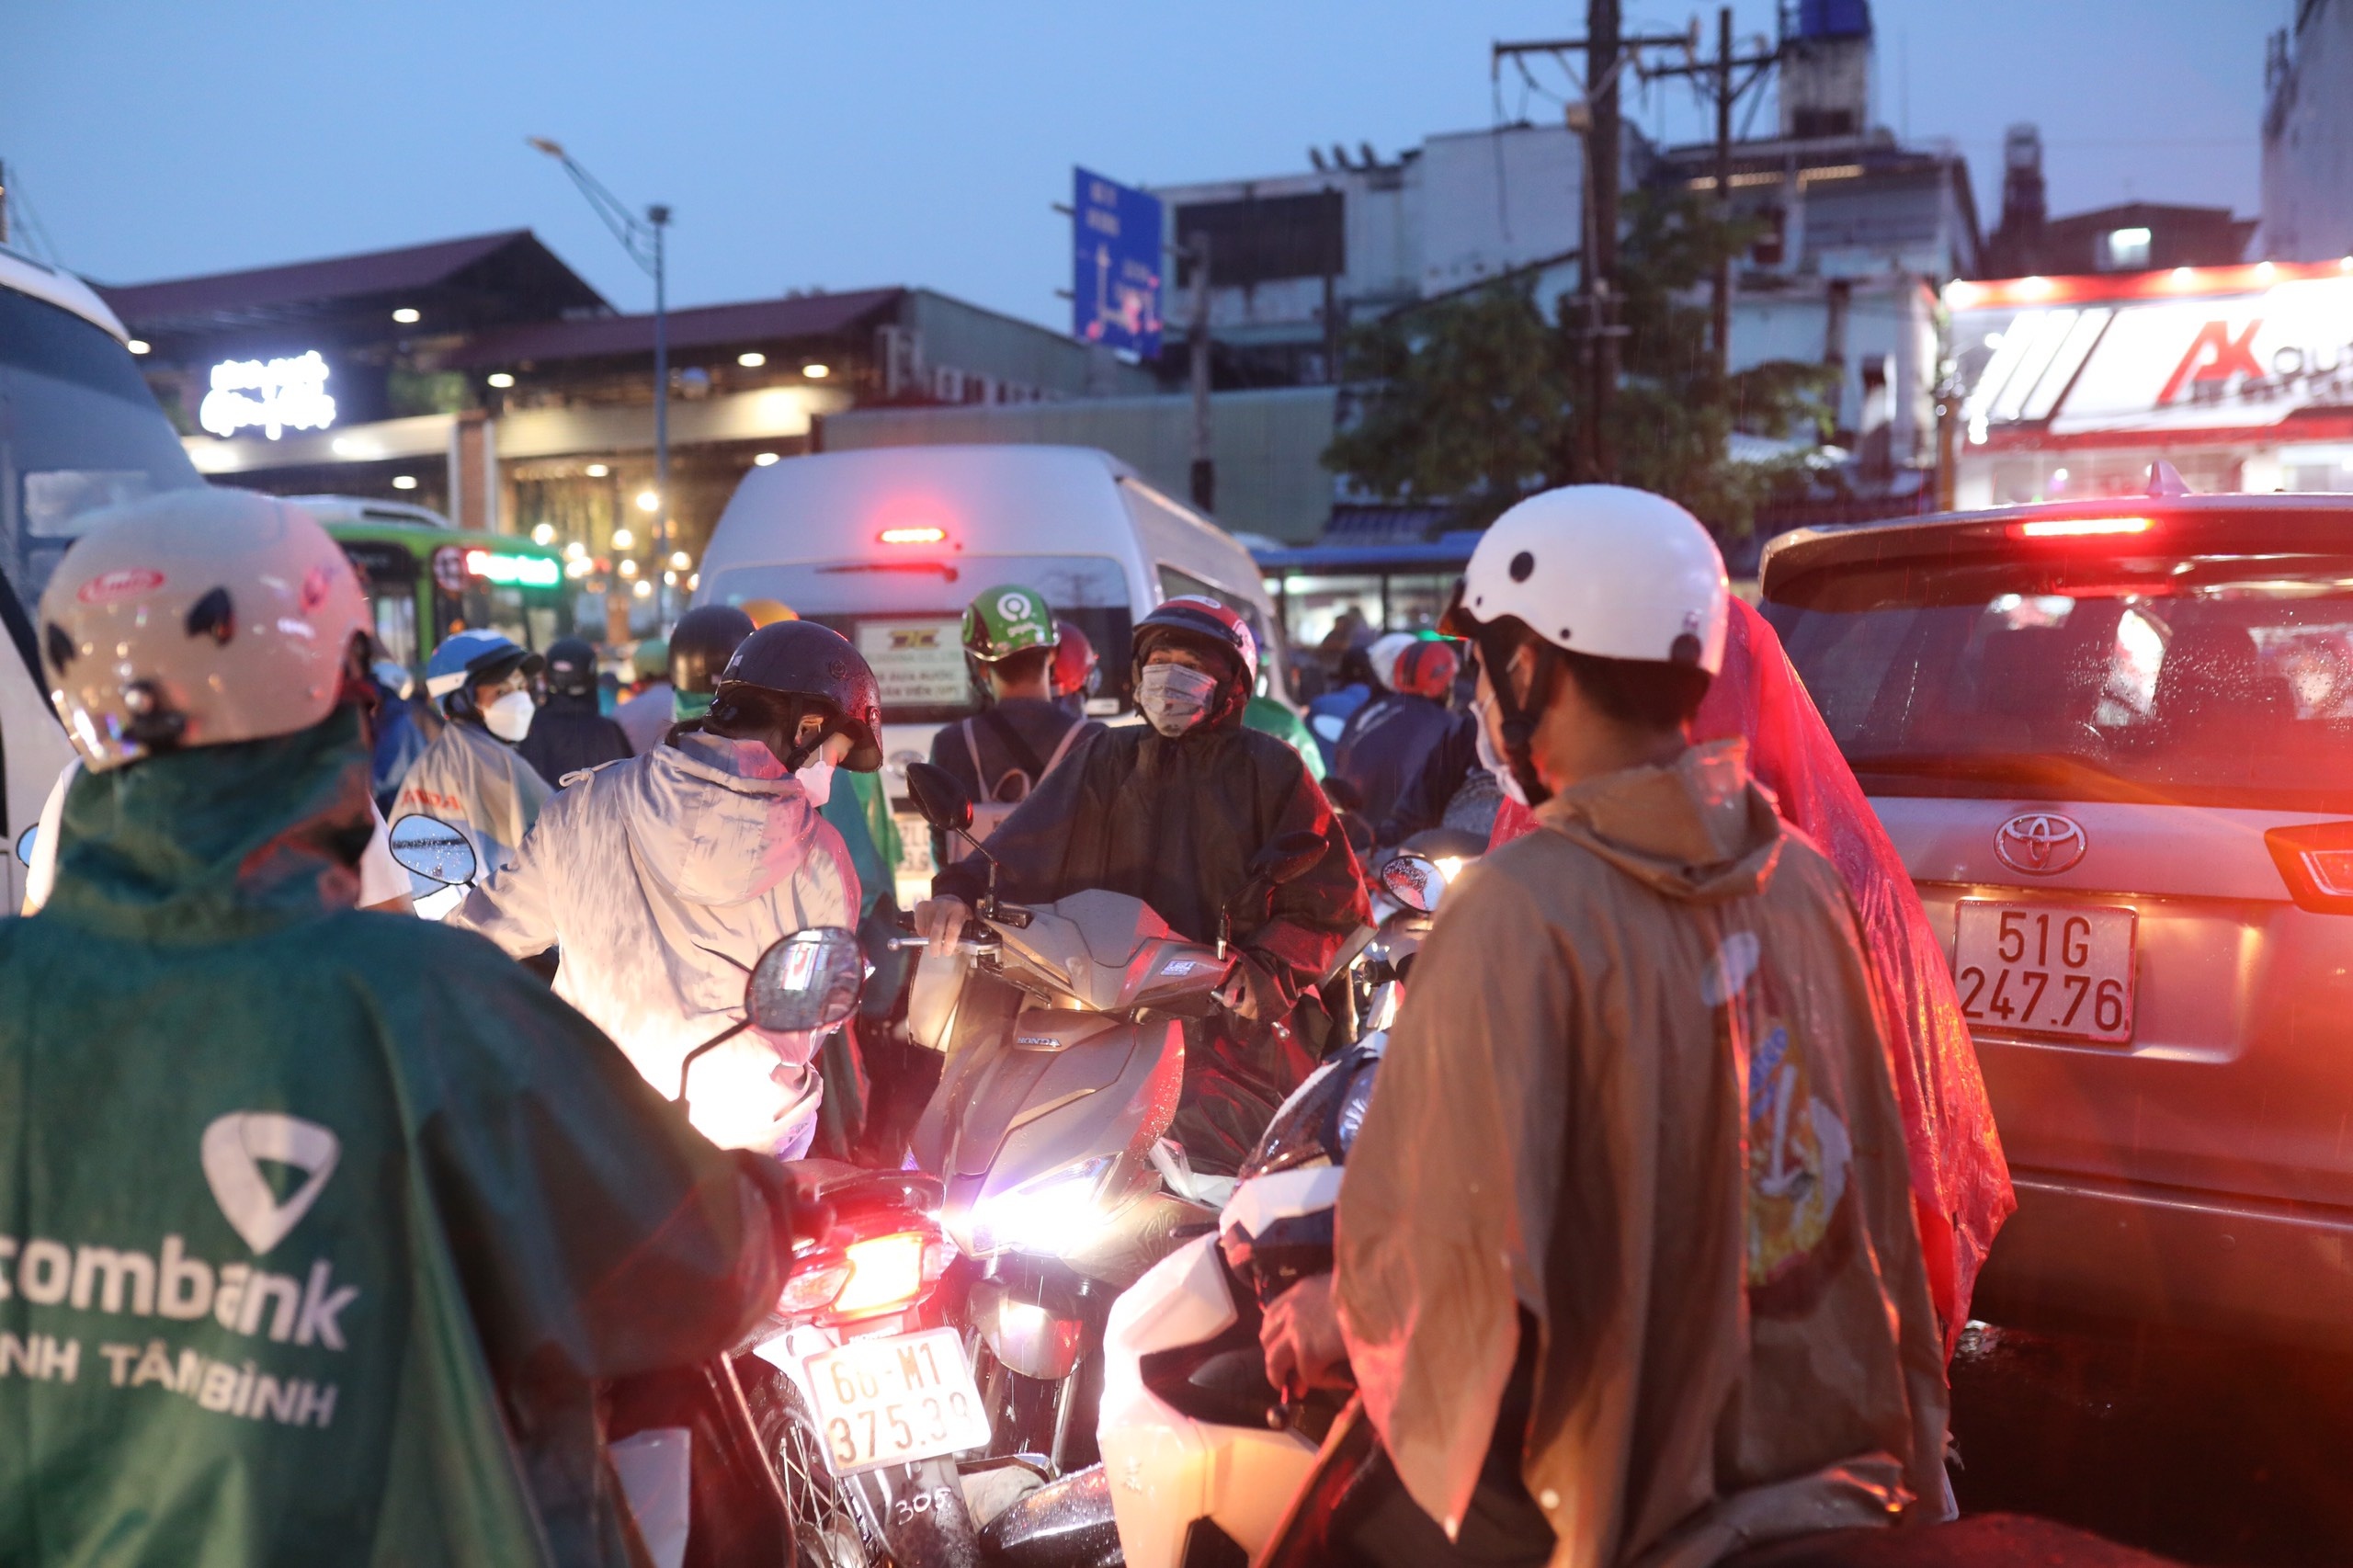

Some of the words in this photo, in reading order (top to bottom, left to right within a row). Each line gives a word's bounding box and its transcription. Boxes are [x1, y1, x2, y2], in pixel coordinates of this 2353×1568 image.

[1998, 911, 2091, 968] 51G
[1960, 967, 2123, 1032] 247.76
[1017, 1037, 1061, 1047] HONDA
